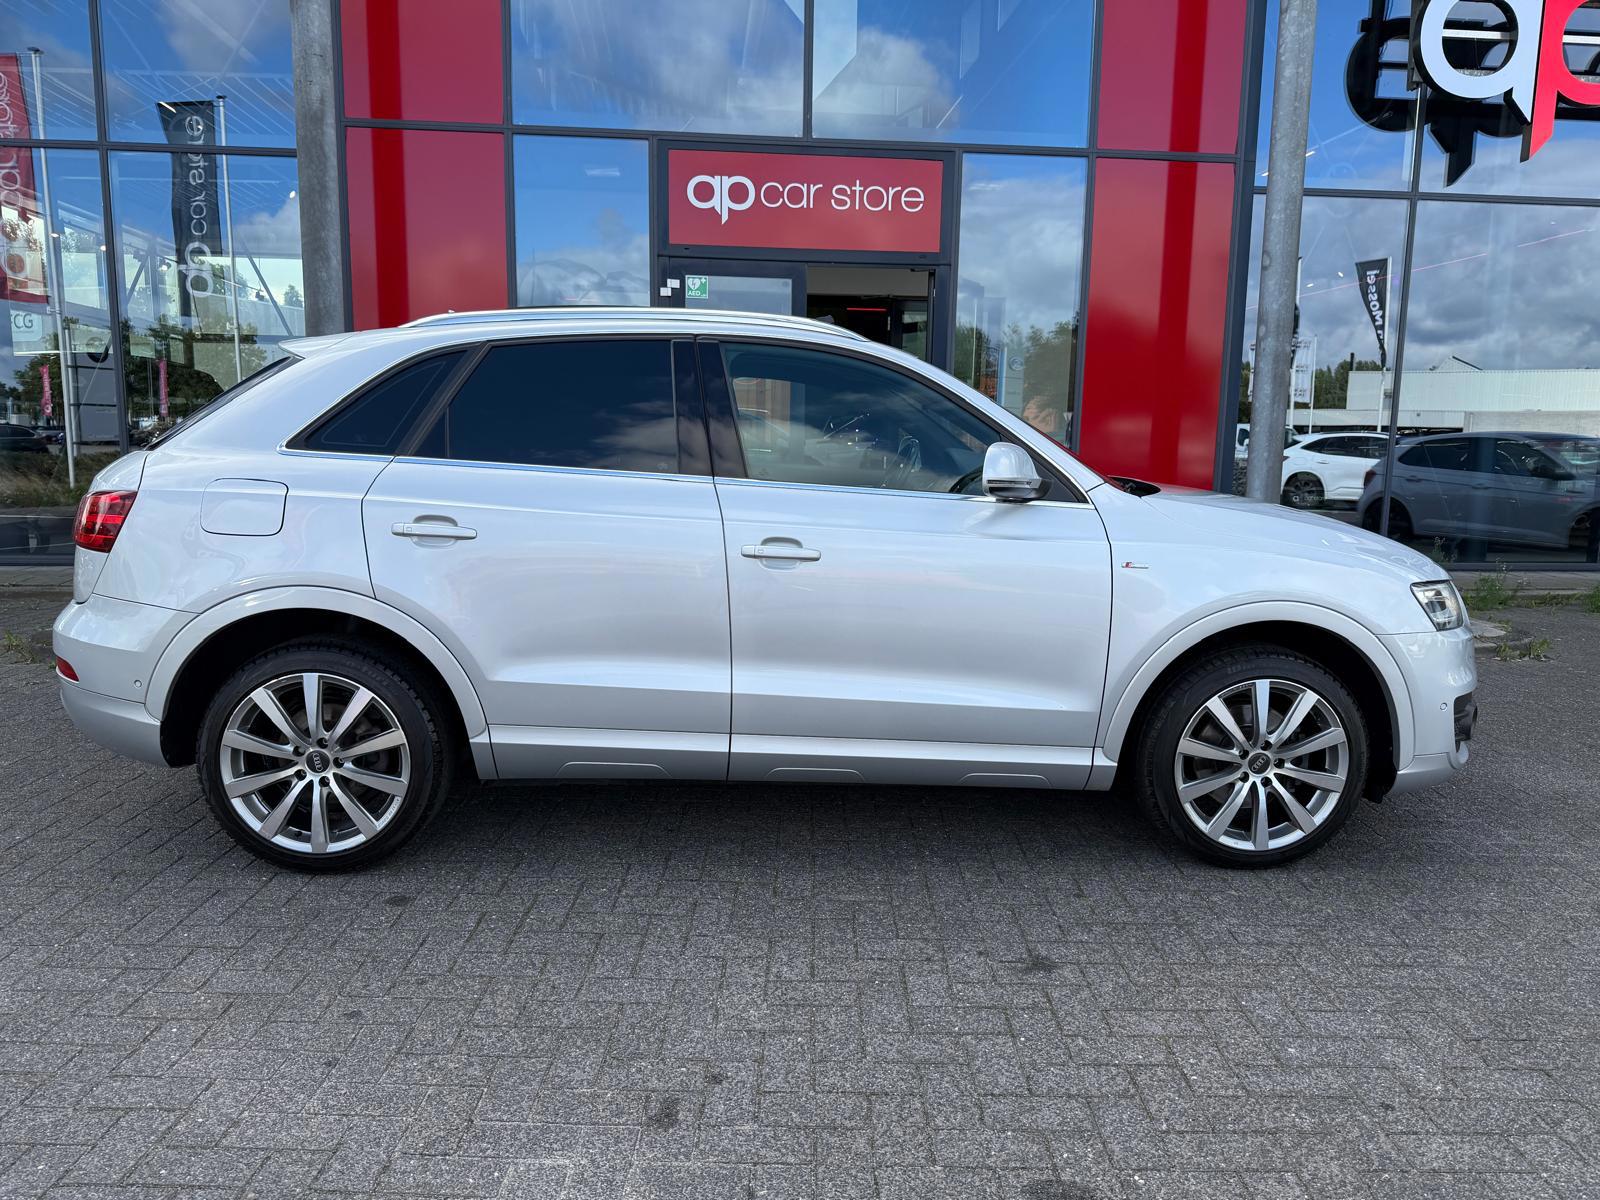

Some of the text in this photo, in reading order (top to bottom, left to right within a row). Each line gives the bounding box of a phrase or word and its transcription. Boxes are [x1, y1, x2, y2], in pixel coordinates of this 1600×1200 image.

[687, 174, 925, 225] ap car store
[10, 312, 34, 330] CG
